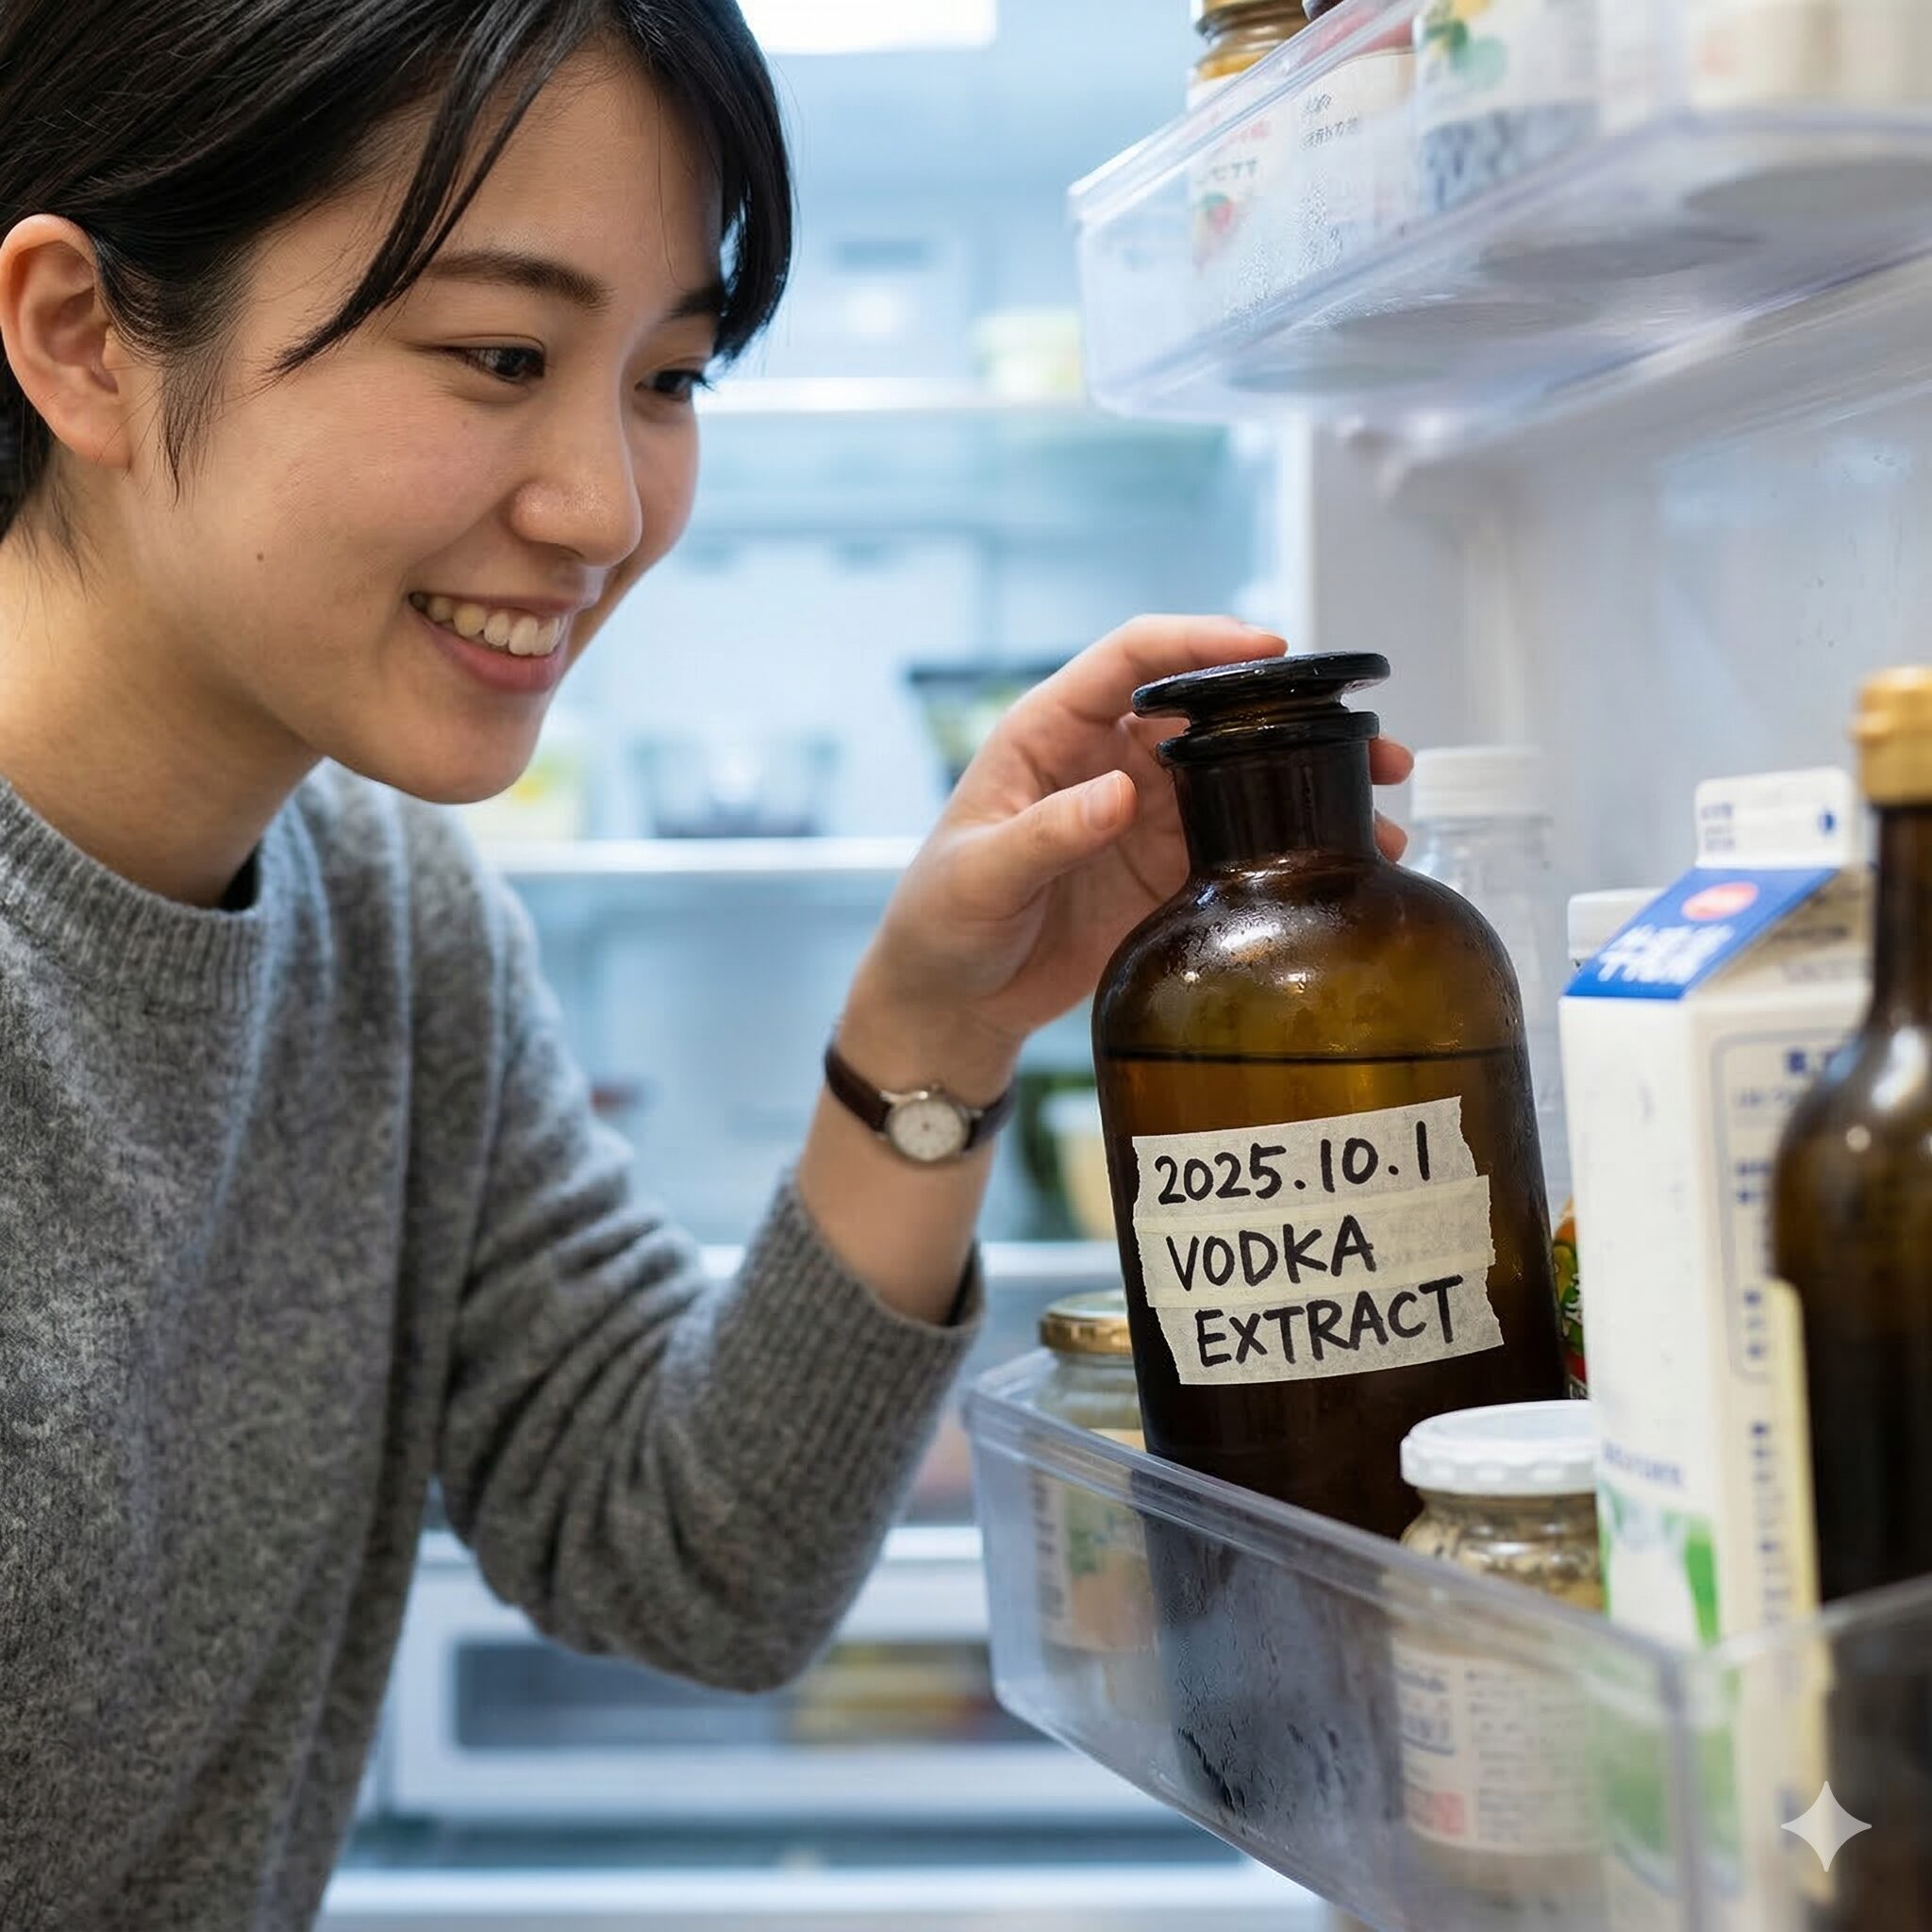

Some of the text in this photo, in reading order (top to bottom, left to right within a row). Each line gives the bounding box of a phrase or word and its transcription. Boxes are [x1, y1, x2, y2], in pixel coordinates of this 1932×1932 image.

[1154, 1120, 1432, 1206] 2025.10.1
[1165, 1214, 1378, 1291] VODKA
[1194, 1274, 1464, 1368] EXTRACT
